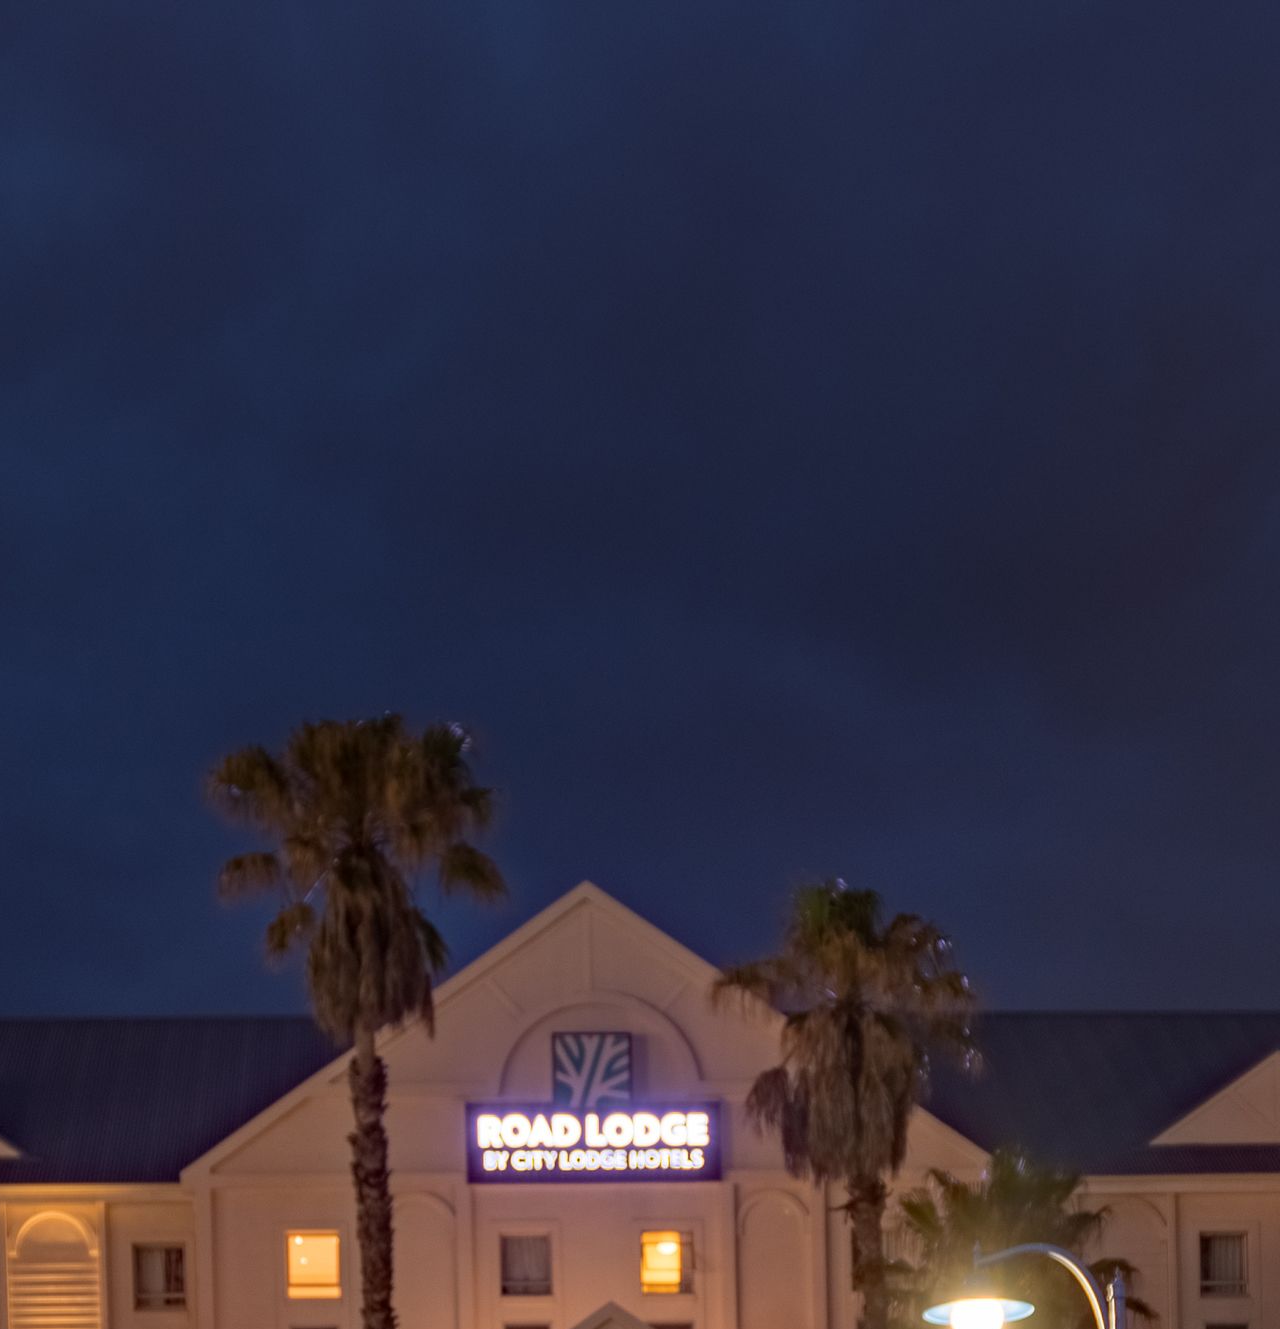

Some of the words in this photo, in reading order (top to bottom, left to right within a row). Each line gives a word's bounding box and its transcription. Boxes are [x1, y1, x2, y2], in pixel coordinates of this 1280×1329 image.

[477, 1113, 581, 1148] ROAD
[584, 1112, 709, 1147] LODGE
[483, 1150, 510, 1171] BY
[510, 1150, 557, 1171] CITY
[559, 1150, 628, 1171] LODGE
[629, 1148, 704, 1170] HOTELS
